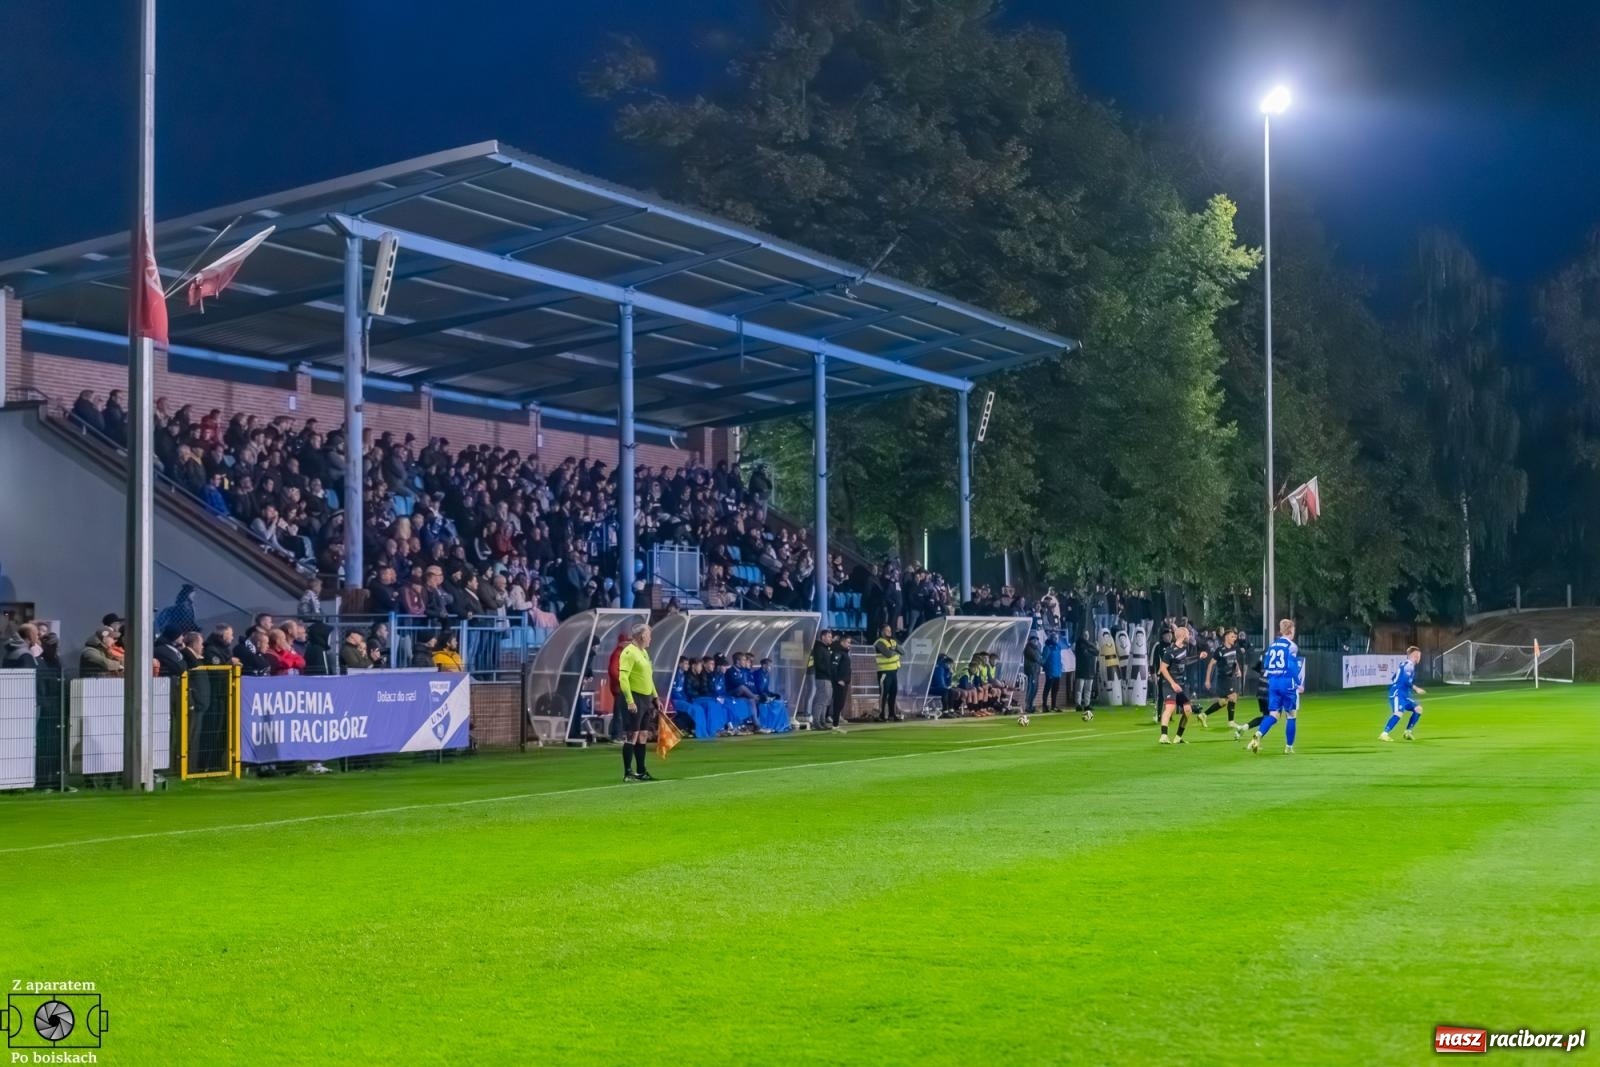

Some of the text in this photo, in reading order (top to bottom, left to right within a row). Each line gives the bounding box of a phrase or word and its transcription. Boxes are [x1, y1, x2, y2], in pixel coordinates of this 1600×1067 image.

[1268, 648, 1285, 669] 23
[251, 691, 334, 716] AKADEMIA
[251, 711, 368, 746] UNII RACIBÓRZ
